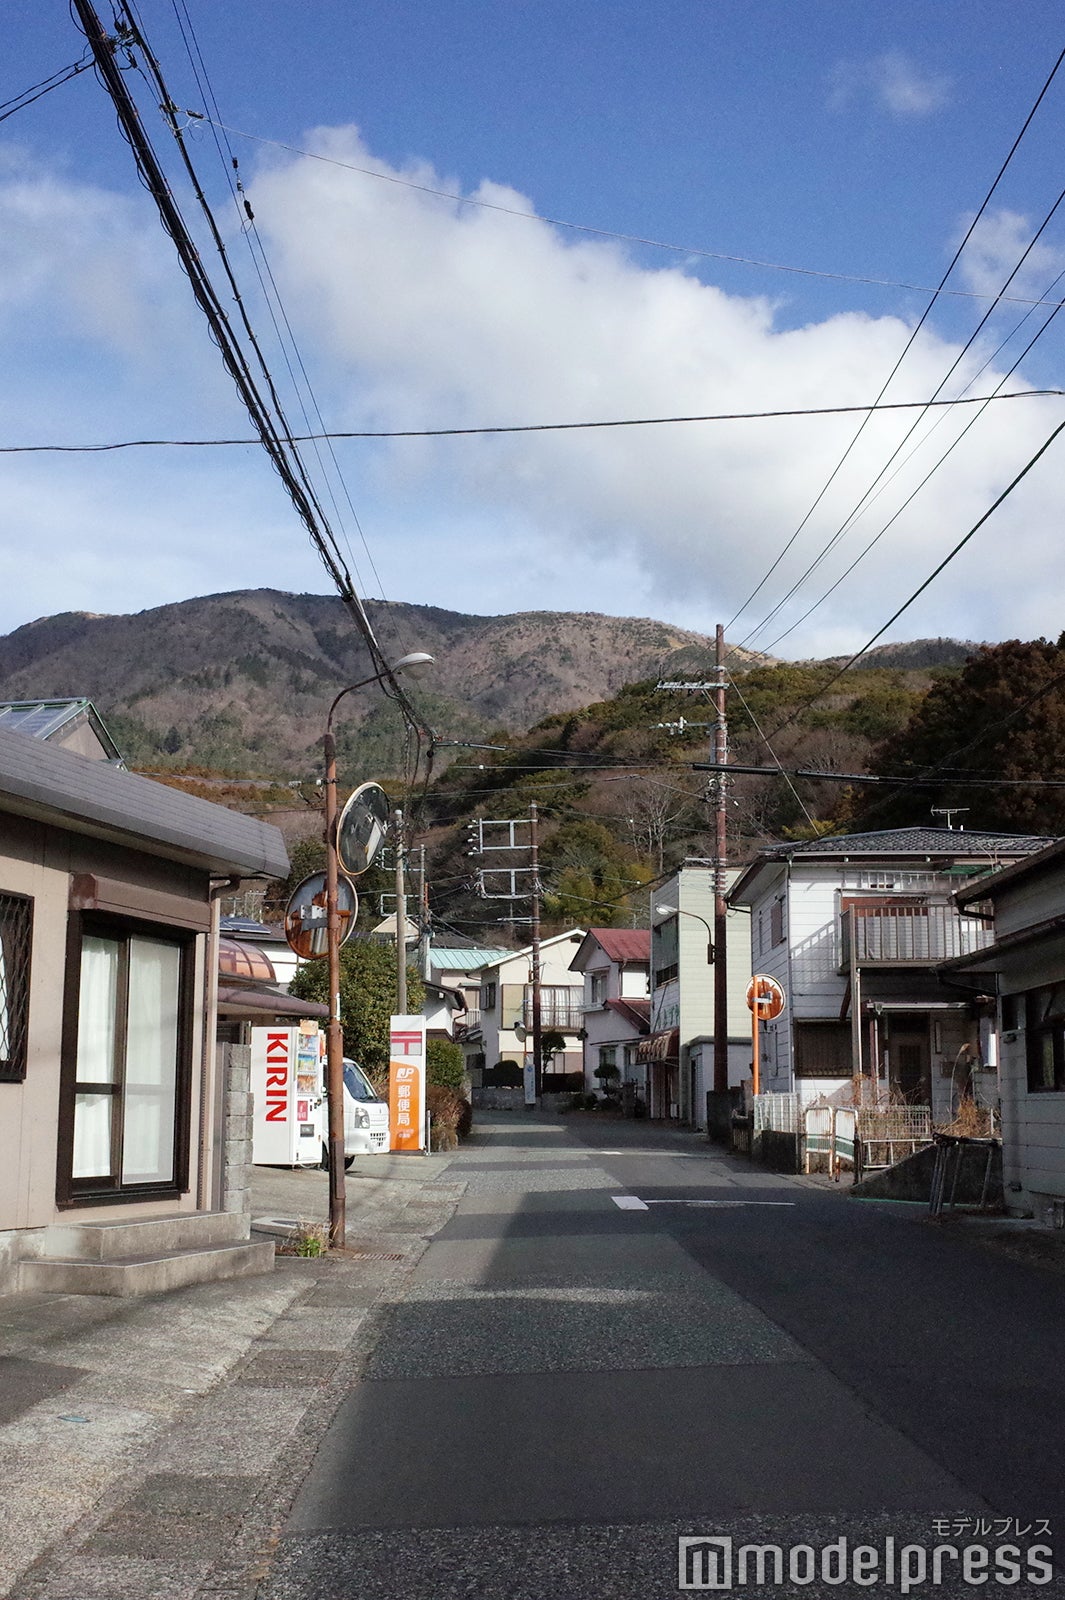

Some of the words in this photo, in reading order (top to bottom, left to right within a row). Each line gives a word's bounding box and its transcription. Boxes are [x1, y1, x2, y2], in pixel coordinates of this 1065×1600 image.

[266, 1034, 288, 1121] KIRIN
[397, 1085, 410, 1126] 郵便局
